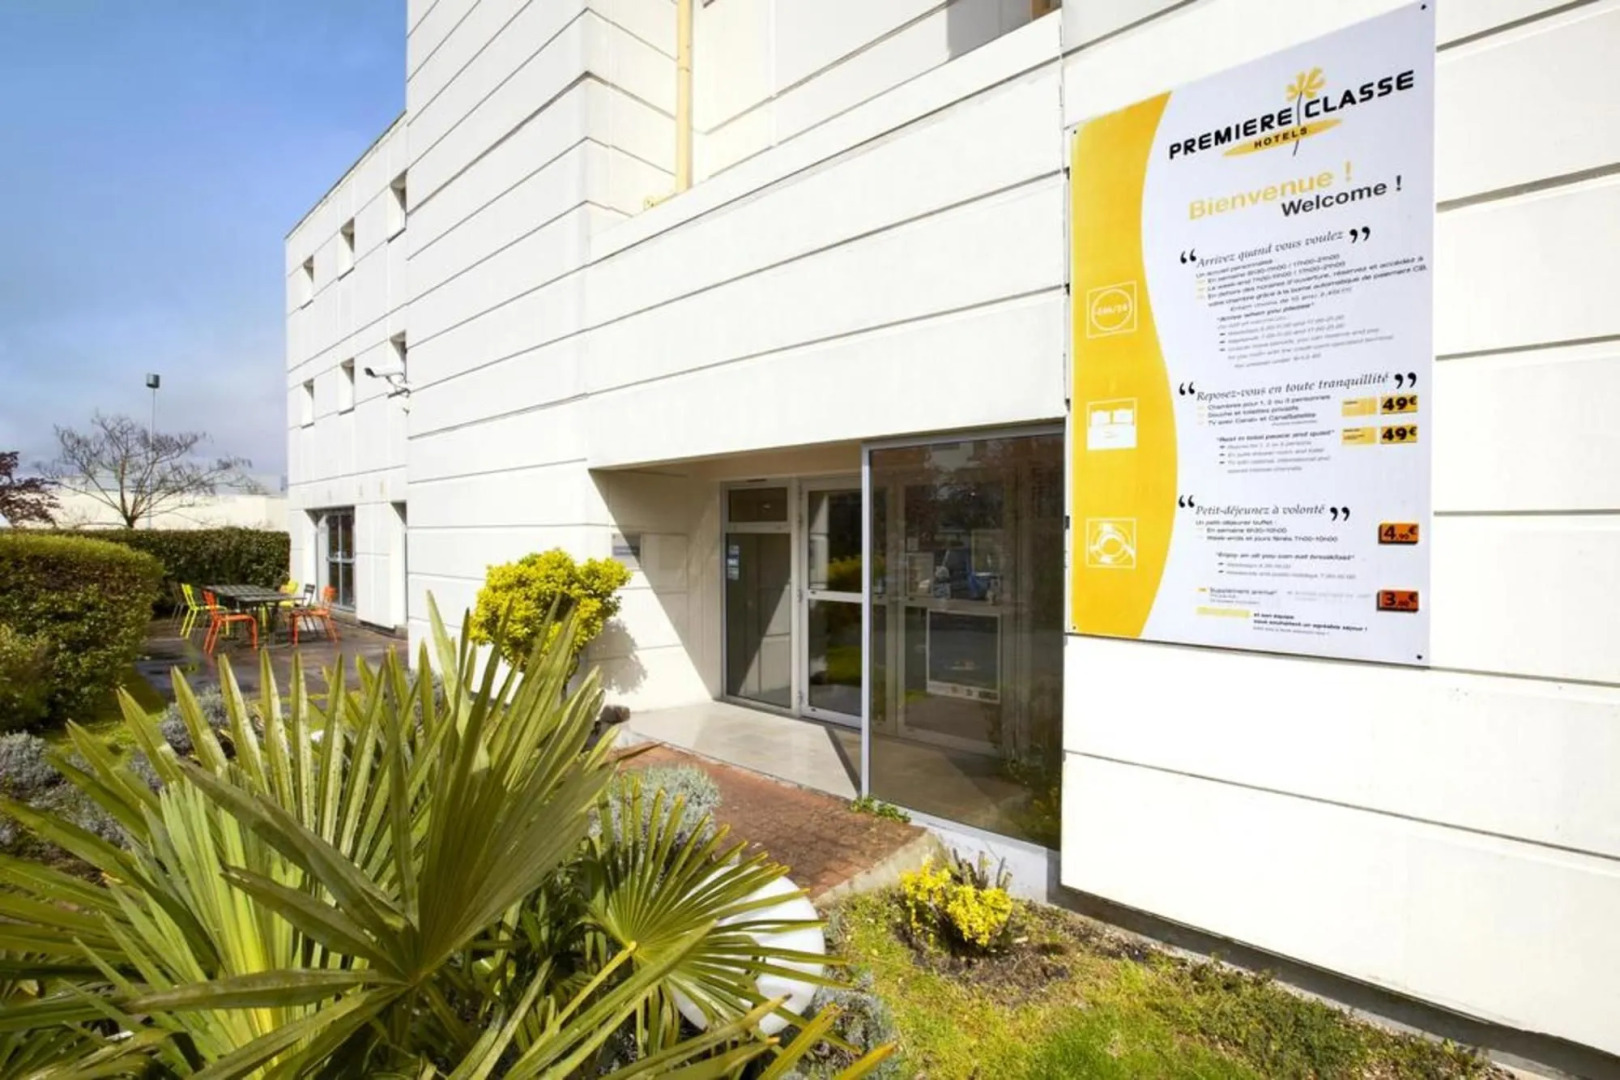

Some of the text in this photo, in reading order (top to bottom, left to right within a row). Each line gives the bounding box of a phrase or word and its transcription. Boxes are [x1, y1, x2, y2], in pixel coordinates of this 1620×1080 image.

[1169, 69, 1413, 159] PREMIERE CLASSE
[1254, 125, 1307, 149] HOTELS
[1188, 159, 1351, 220] Bienvenue !
[1281, 174, 1401, 217] Welcome !
[1197, 228, 1342, 268] Arrivez quand vous voulez
[1197, 373, 1388, 403] Reposez-vous en toute tranquillité
[1382, 394, 1417, 411] 49€
[1382, 425, 1417, 441] 49€
[1195, 503, 1325, 517] Petit-déjeunez à volonté
